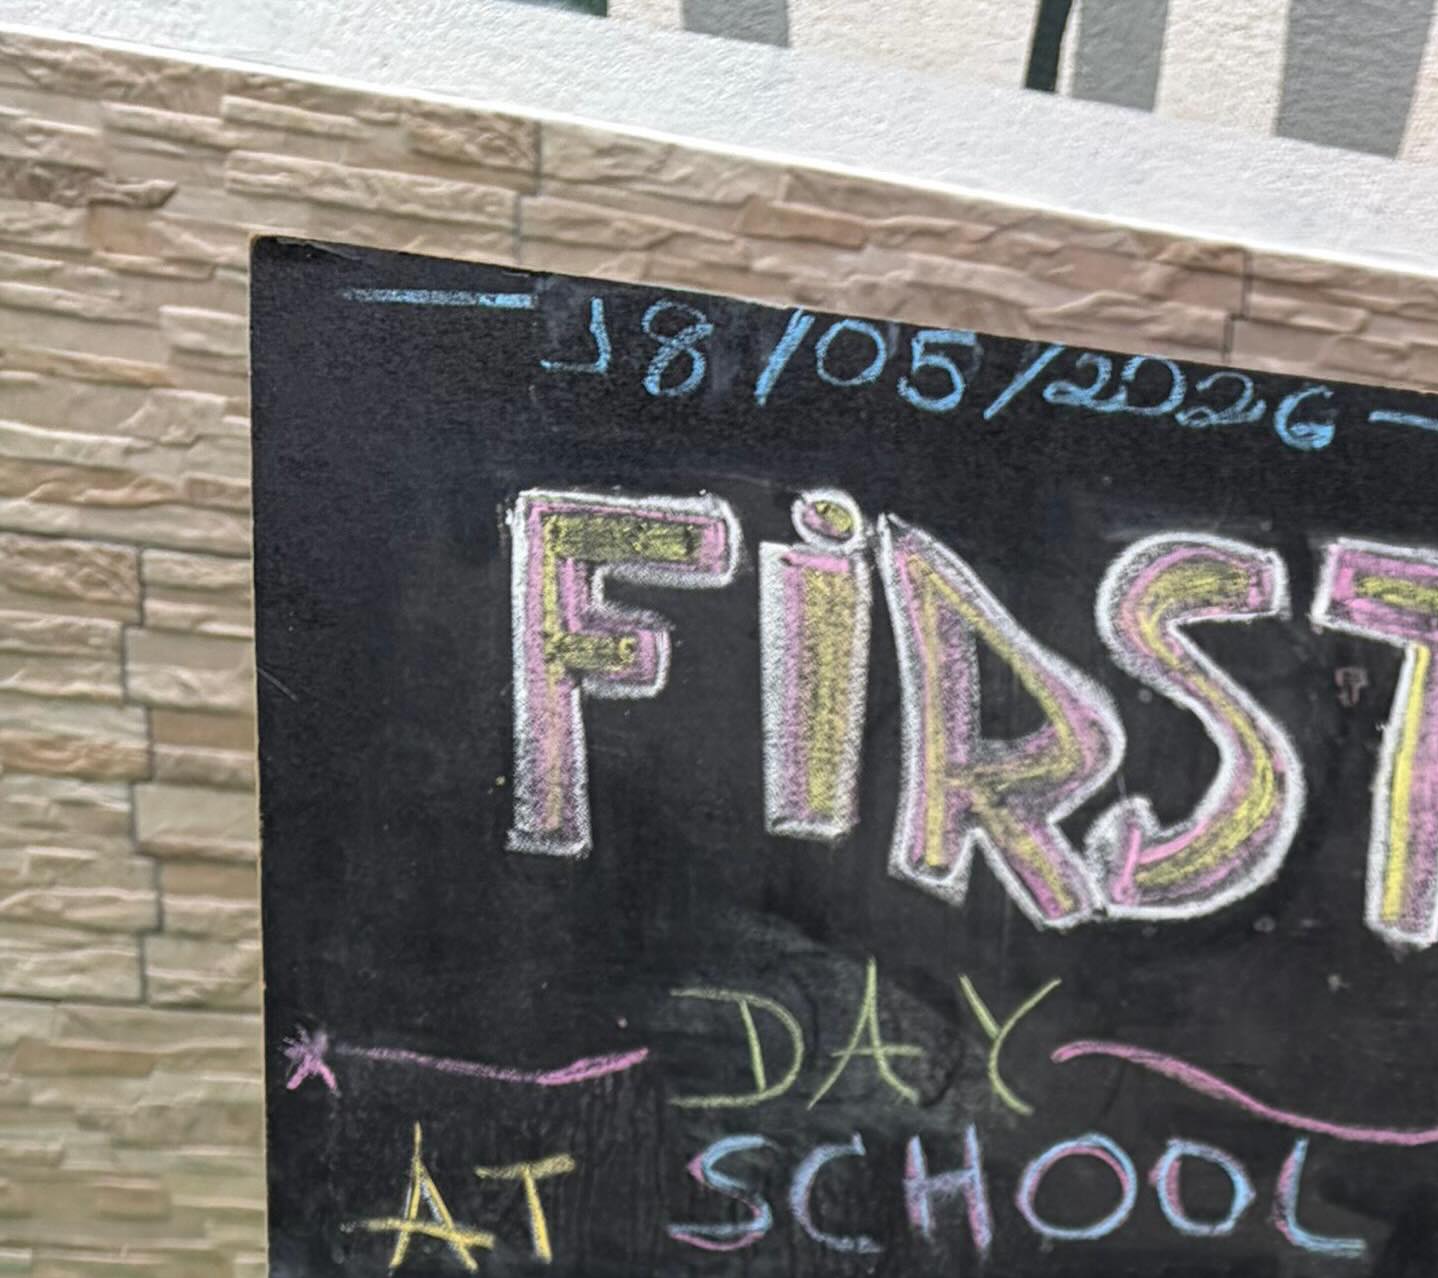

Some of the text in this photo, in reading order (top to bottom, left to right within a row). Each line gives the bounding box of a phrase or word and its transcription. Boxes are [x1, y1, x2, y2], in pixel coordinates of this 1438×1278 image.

[669, 959, 1061, 1113] DAY
[341, 1123, 1367, 1270] AT SCHOOL
